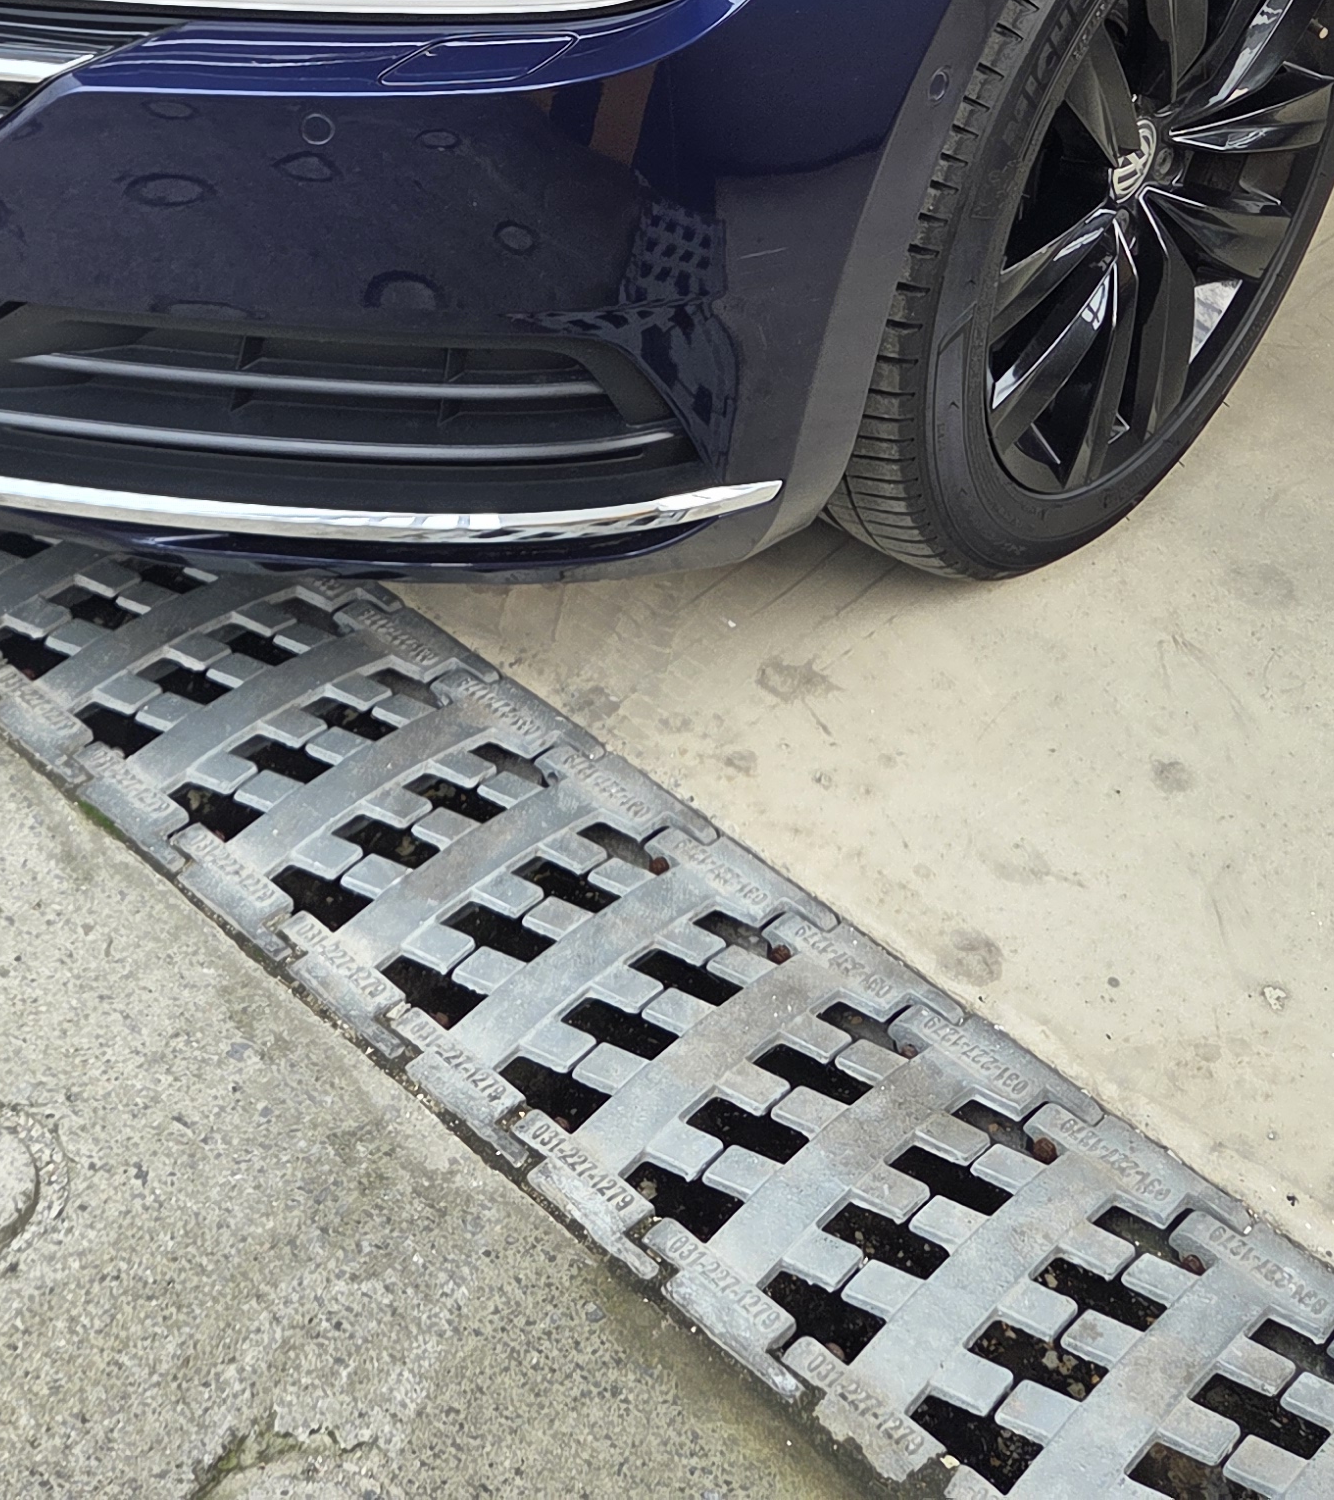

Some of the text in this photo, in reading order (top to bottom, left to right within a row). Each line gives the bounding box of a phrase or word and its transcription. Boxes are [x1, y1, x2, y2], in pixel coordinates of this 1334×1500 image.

[296, 920, 388, 1000] 031-227-1279
[409, 1020, 508, 1104] 031-227-1279
[922, 1014, 1030, 1098] 031-227-1279
[530, 1121, 636, 1212] 031-227-1279
[668, 1232, 783, 1334] 031-227-1279
[1208, 1223, 1328, 1317] 031-227-1279
